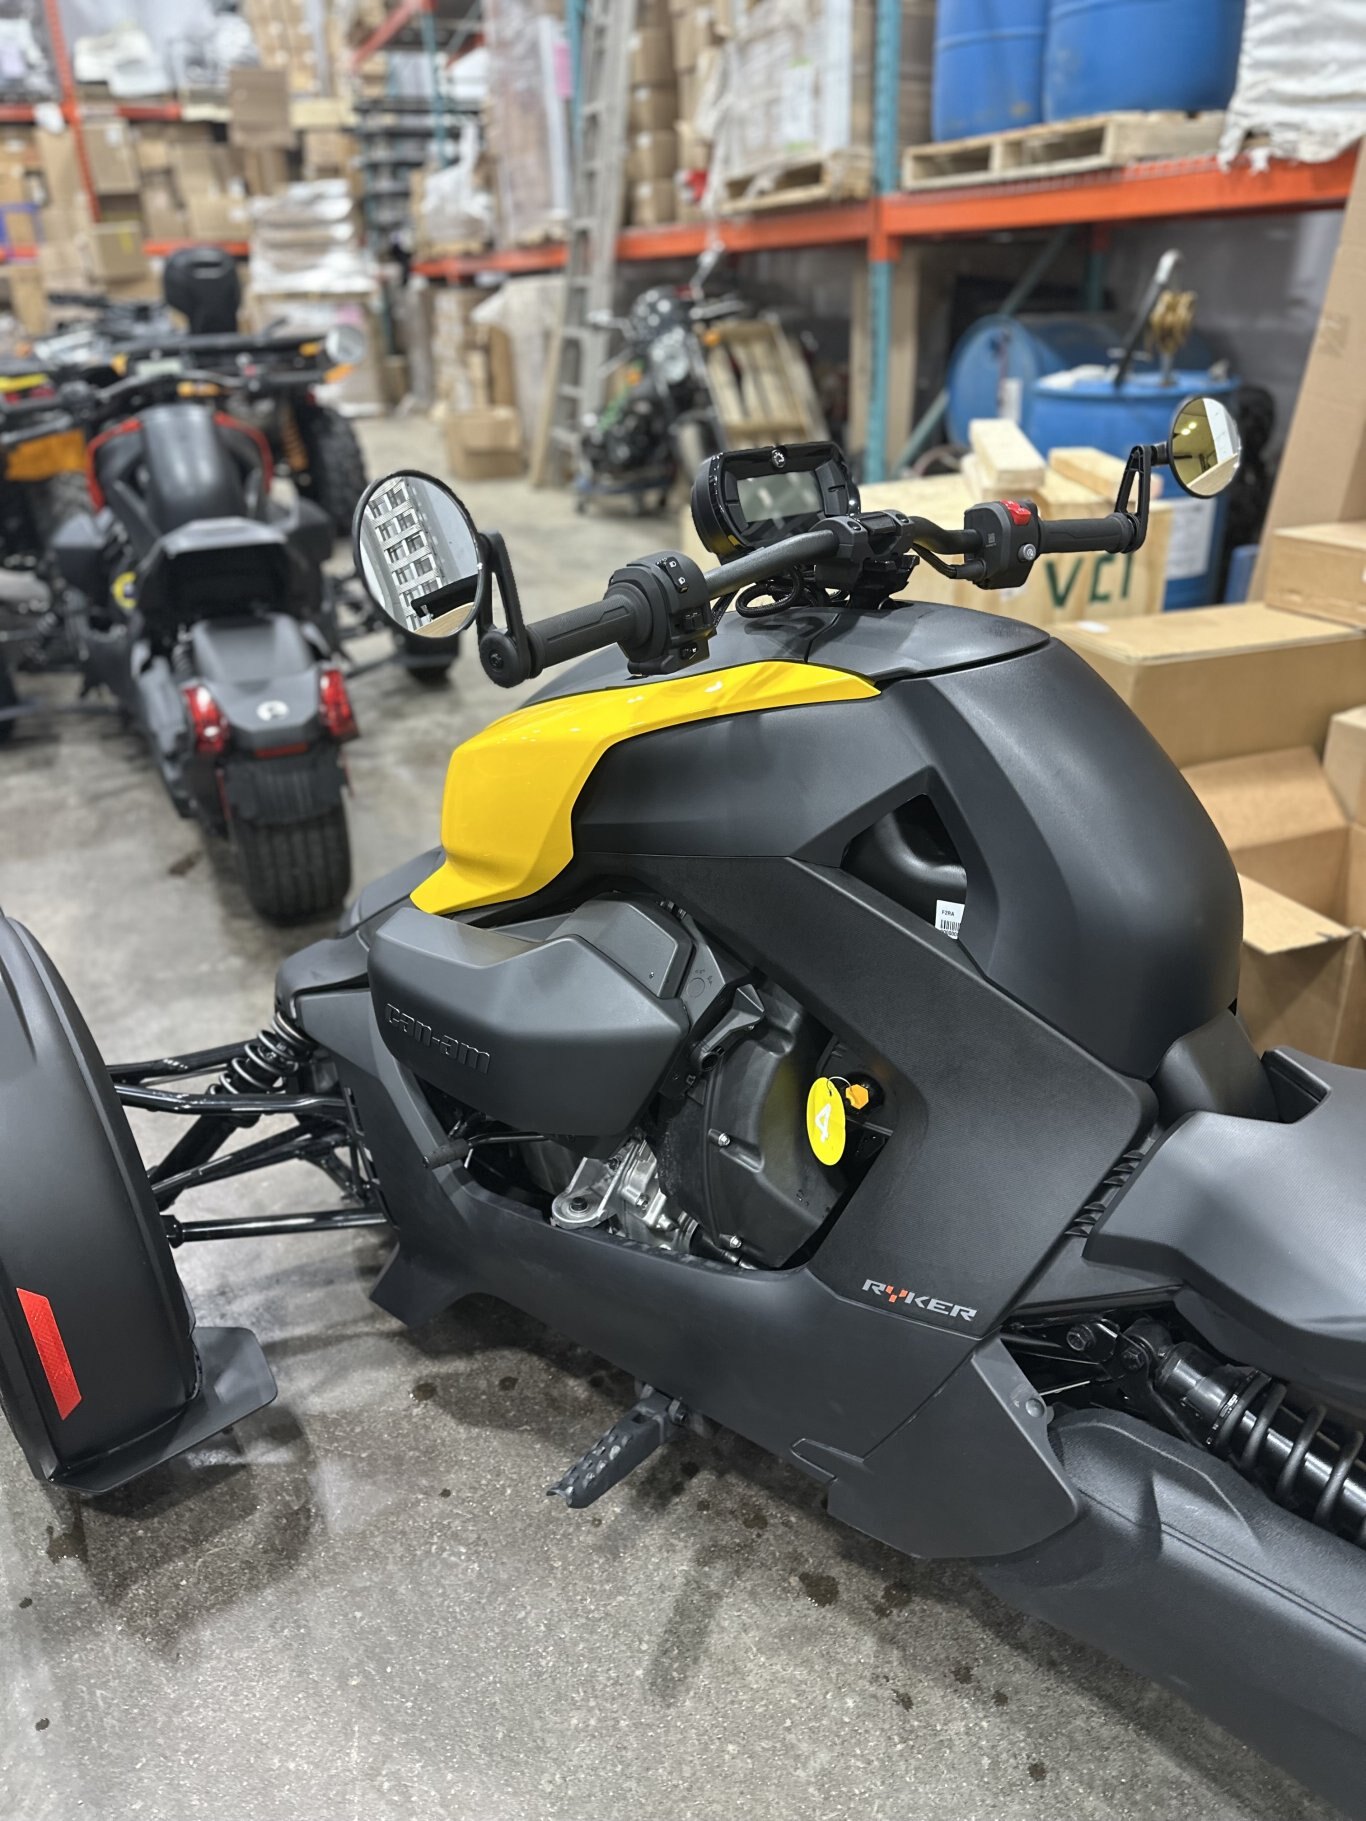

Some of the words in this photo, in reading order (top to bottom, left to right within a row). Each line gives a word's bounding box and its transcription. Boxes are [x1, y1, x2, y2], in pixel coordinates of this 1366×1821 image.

[385, 1003, 490, 1075] can-am
[815, 1103, 831, 1143] 4
[862, 1279, 977, 1321] RYKER
